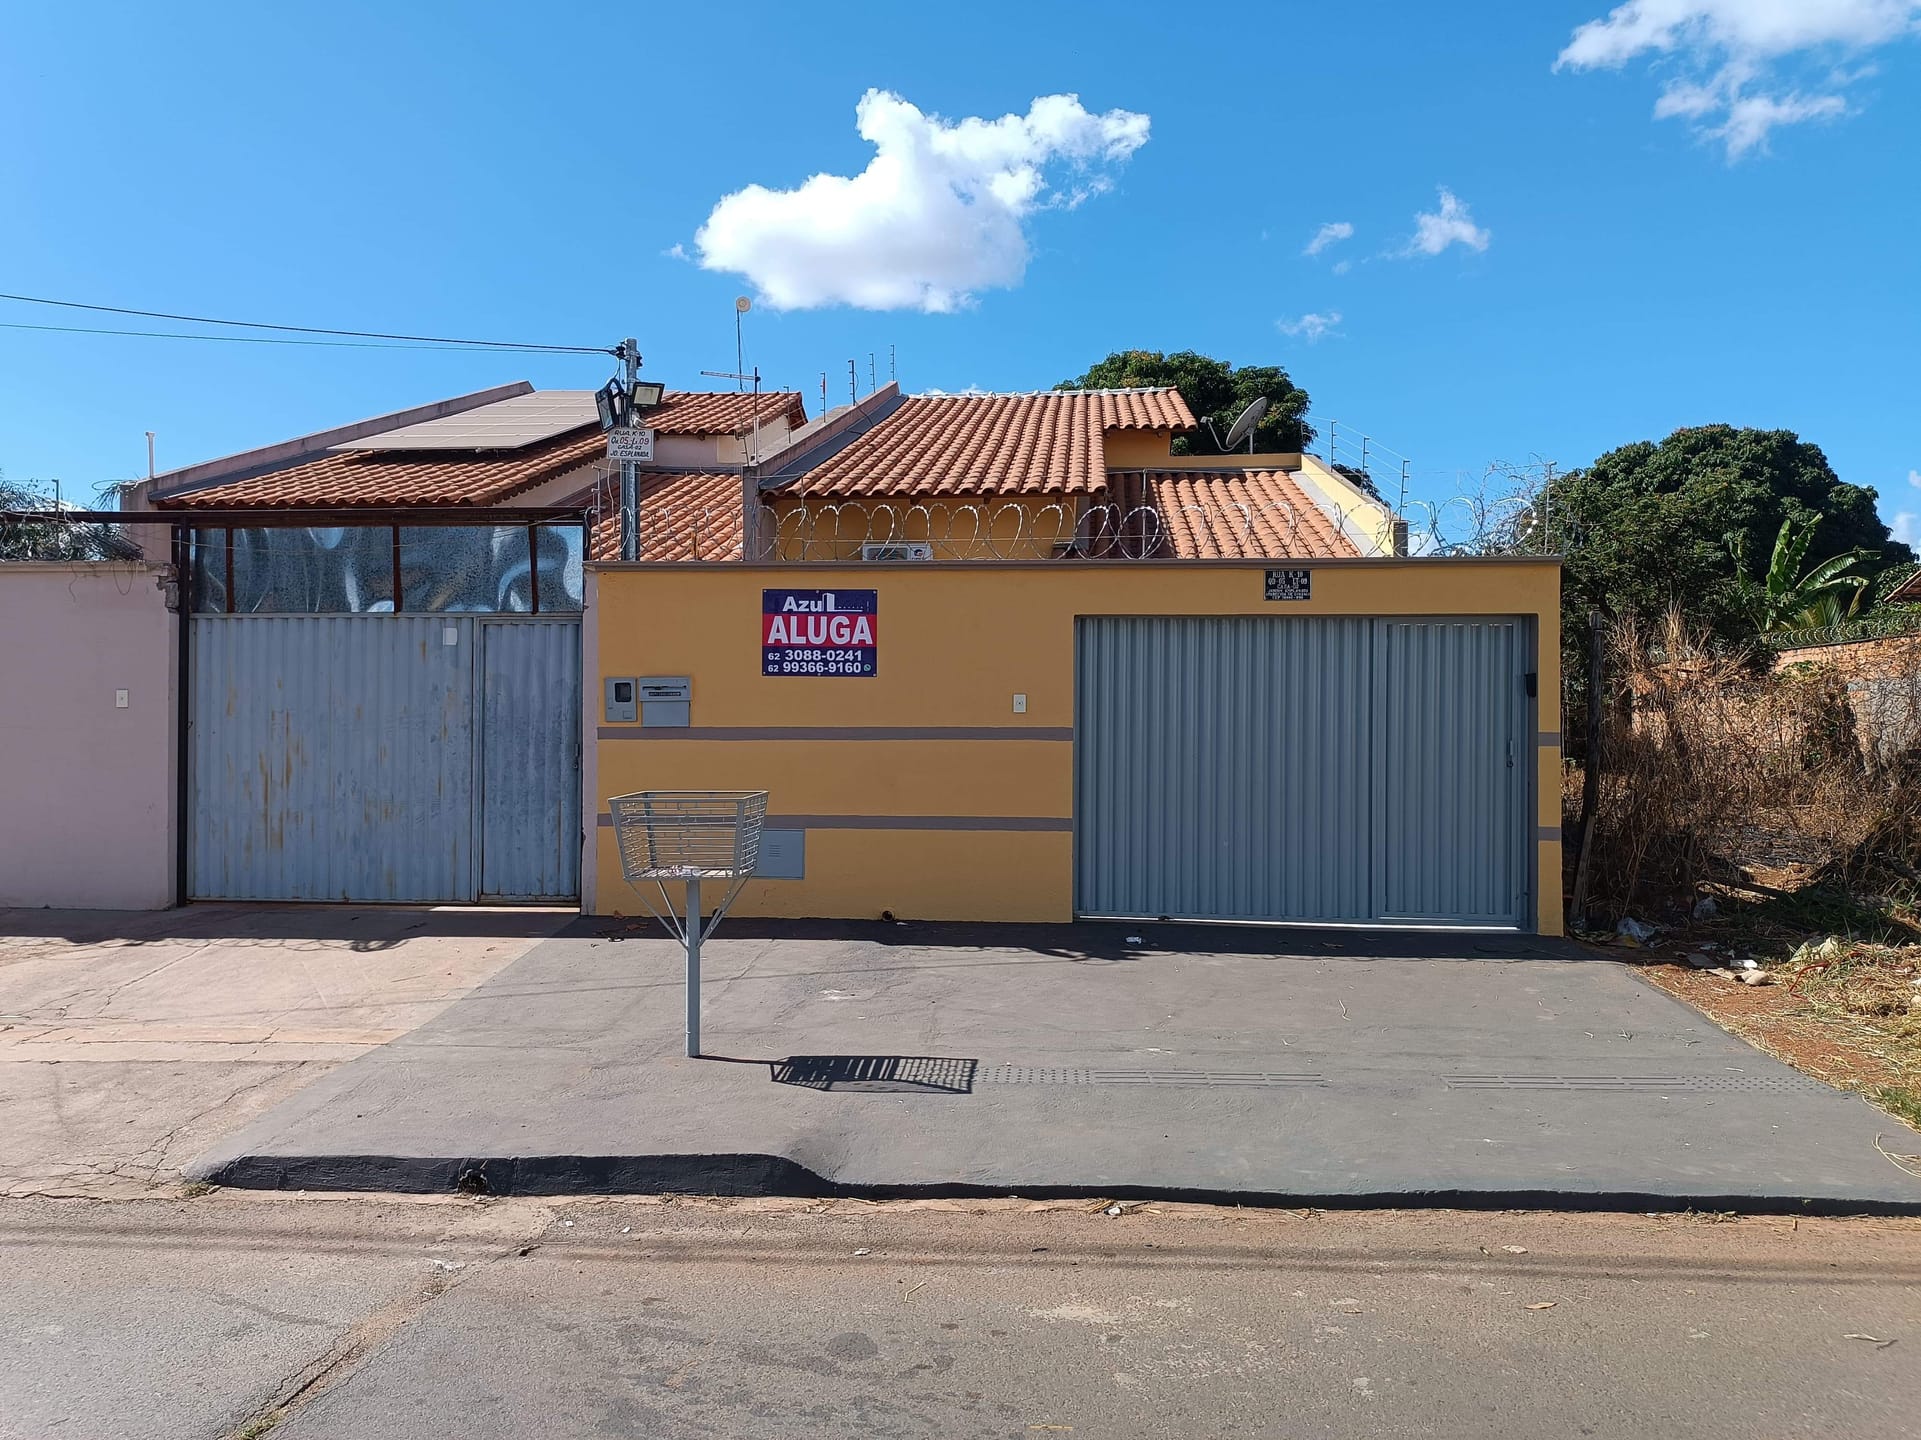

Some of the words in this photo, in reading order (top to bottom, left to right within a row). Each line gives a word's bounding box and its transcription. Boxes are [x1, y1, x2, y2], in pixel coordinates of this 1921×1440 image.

[767, 615, 873, 645] ALUGA
[767, 652, 781, 660] 62
[784, 650, 862, 661] 3088-0241
[767, 664, 779, 672] 62
[783, 662, 861, 673] 99366-9160
